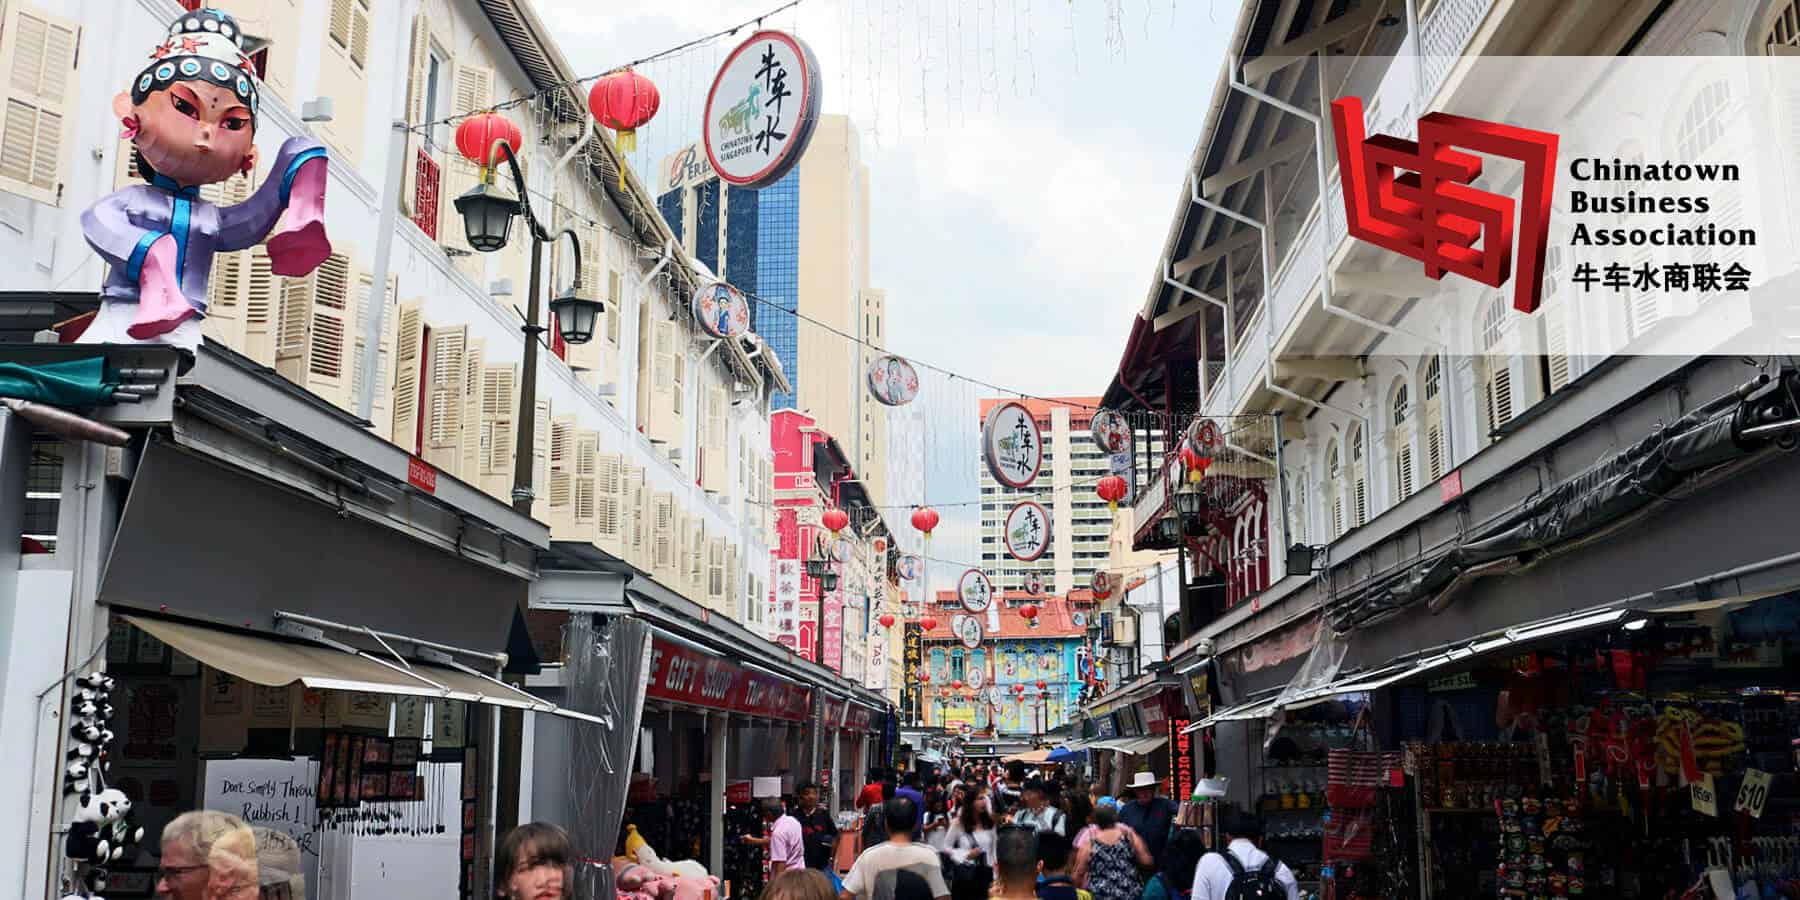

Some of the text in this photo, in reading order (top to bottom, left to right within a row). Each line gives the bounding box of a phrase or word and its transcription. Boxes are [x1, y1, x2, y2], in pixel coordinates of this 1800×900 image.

[720, 133, 754, 152] CHINATOWN
[720, 144, 753, 162] SINGAPORE
[665, 655, 702, 694] GIFT
[701, 659, 734, 699] SHOP
[1175, 719, 1190, 756] MONEY
[1738, 783, 1765, 811] $10
[241, 801, 290, 823] Rubbish
